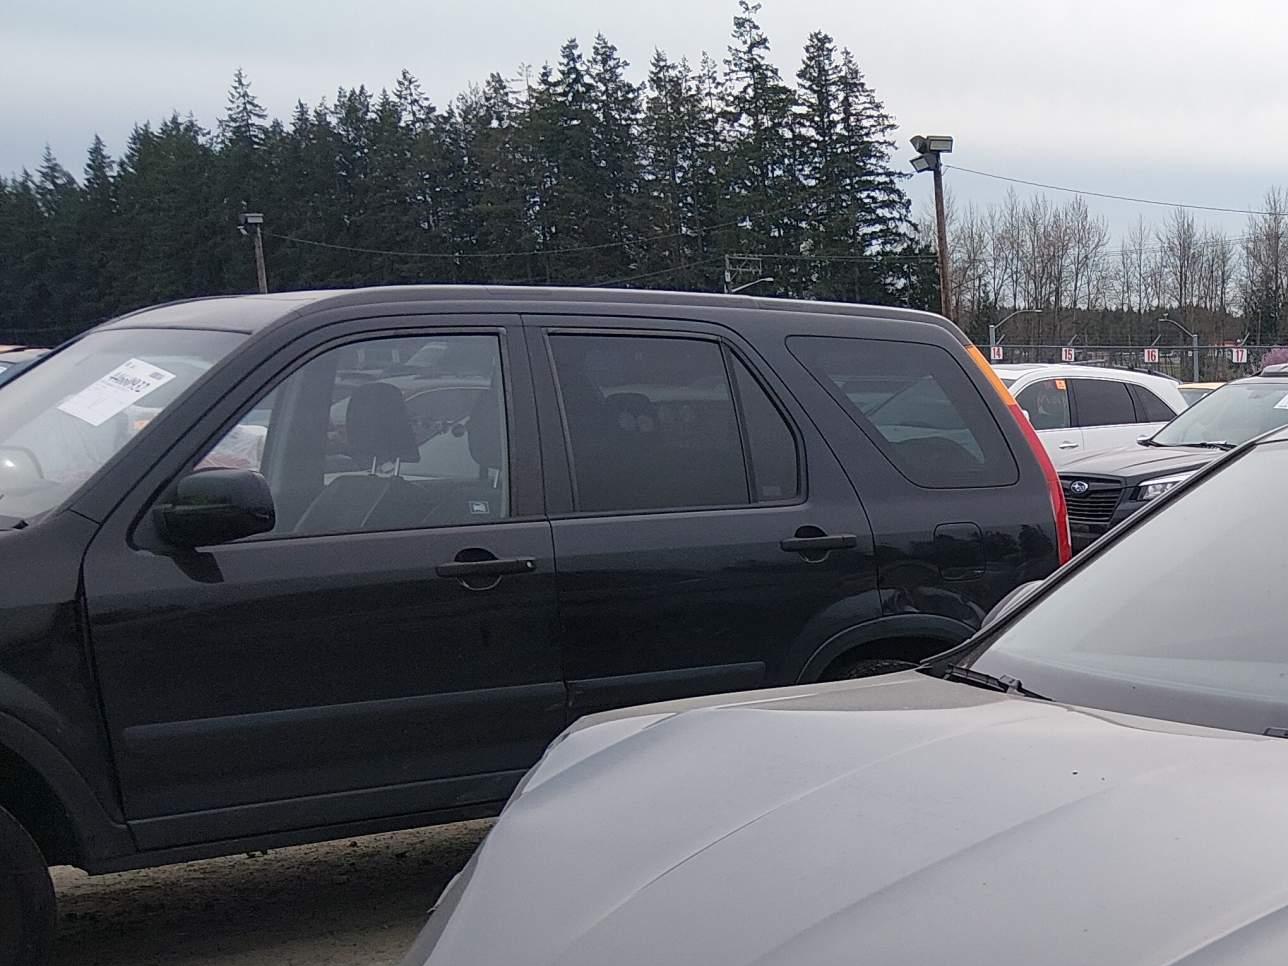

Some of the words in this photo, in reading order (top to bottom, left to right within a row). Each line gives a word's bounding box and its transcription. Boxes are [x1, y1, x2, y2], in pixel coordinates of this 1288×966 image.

[992, 347, 1001, 359] 14
[1064, 348, 1073, 361] 15
[1147, 349, 1157, 362] 16
[1235, 349, 1245, 362] 17
